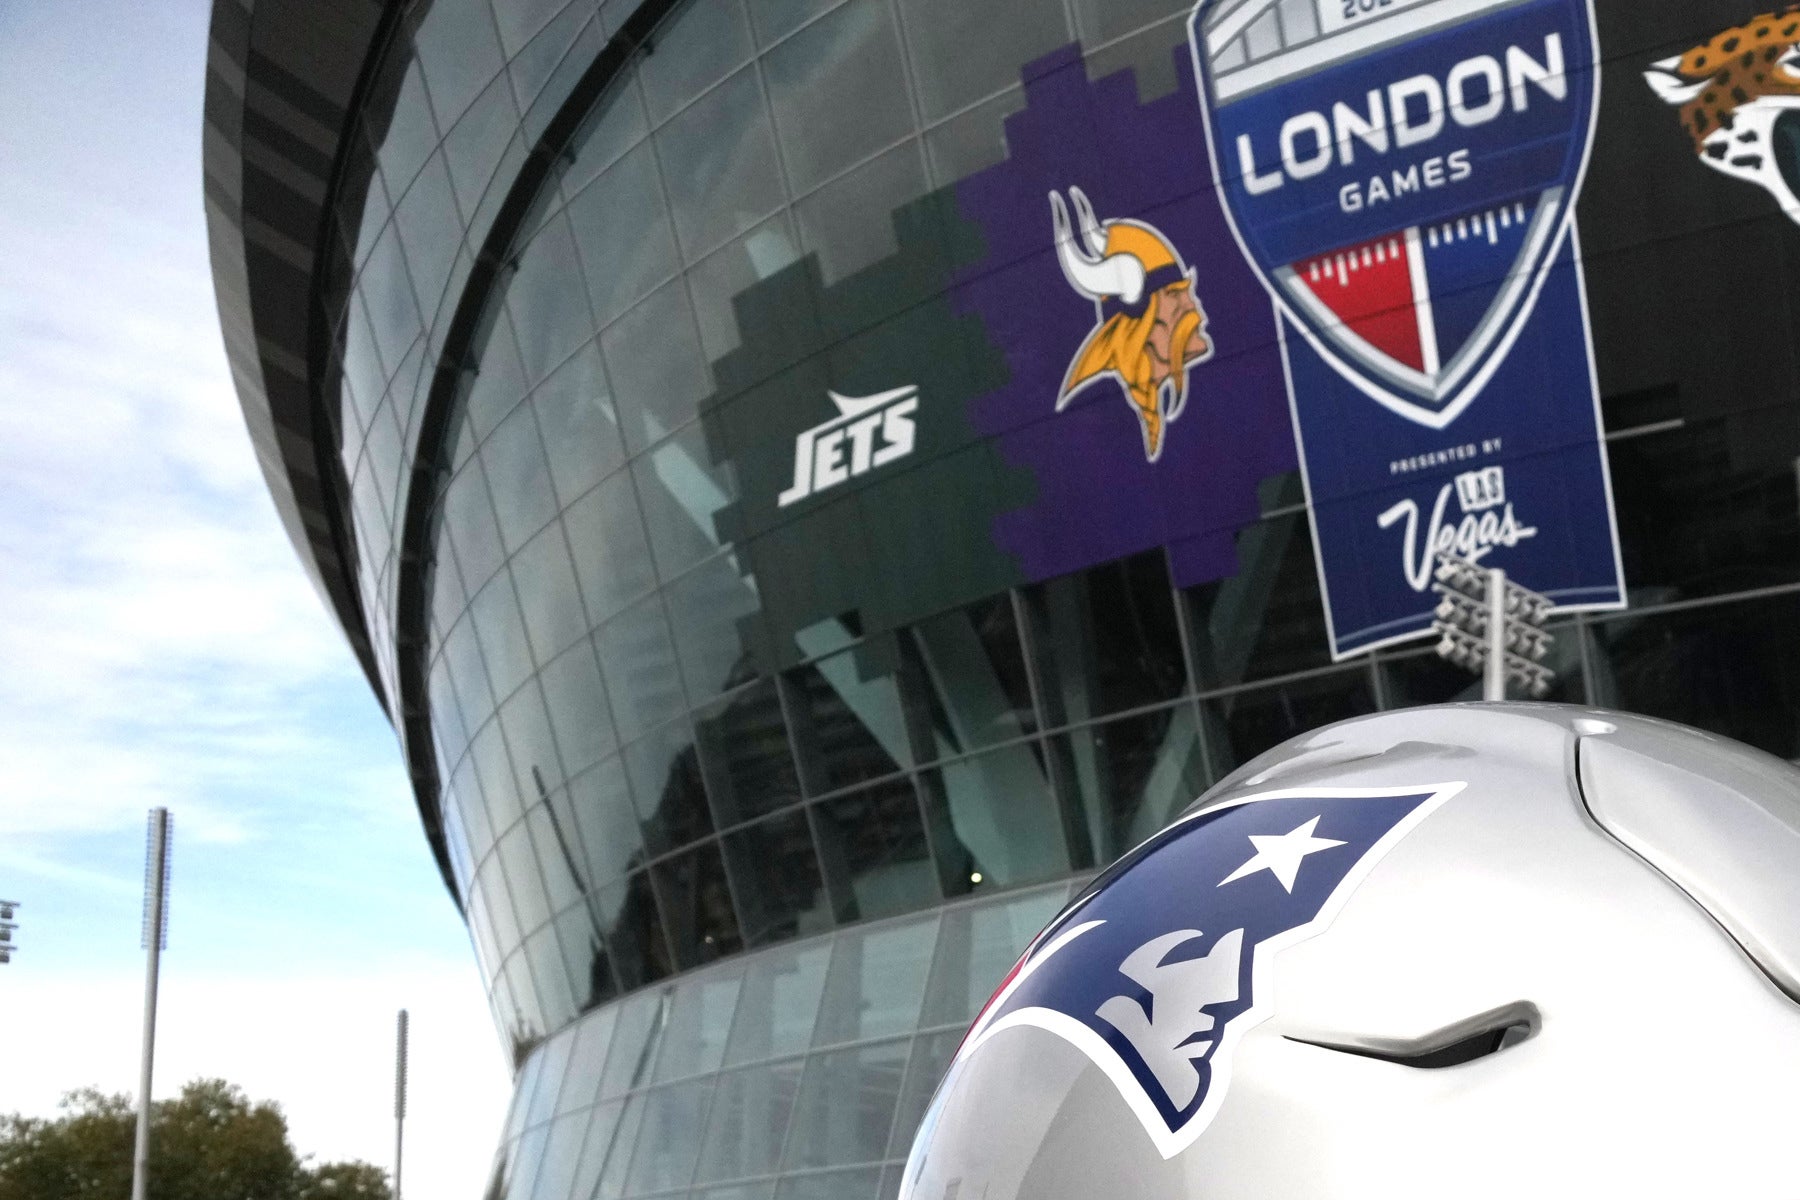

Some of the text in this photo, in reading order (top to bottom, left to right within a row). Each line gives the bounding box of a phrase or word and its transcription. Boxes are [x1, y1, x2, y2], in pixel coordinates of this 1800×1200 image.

[1236, 32, 1569, 196] LONDON
[1339, 149, 1472, 213] GAMES
[777, 384, 919, 508] JETS
[1390, 438, 1501, 475] PRESENTED BY
[1458, 469, 1502, 509] LAS
[1377, 483, 1538, 592] Vegas
